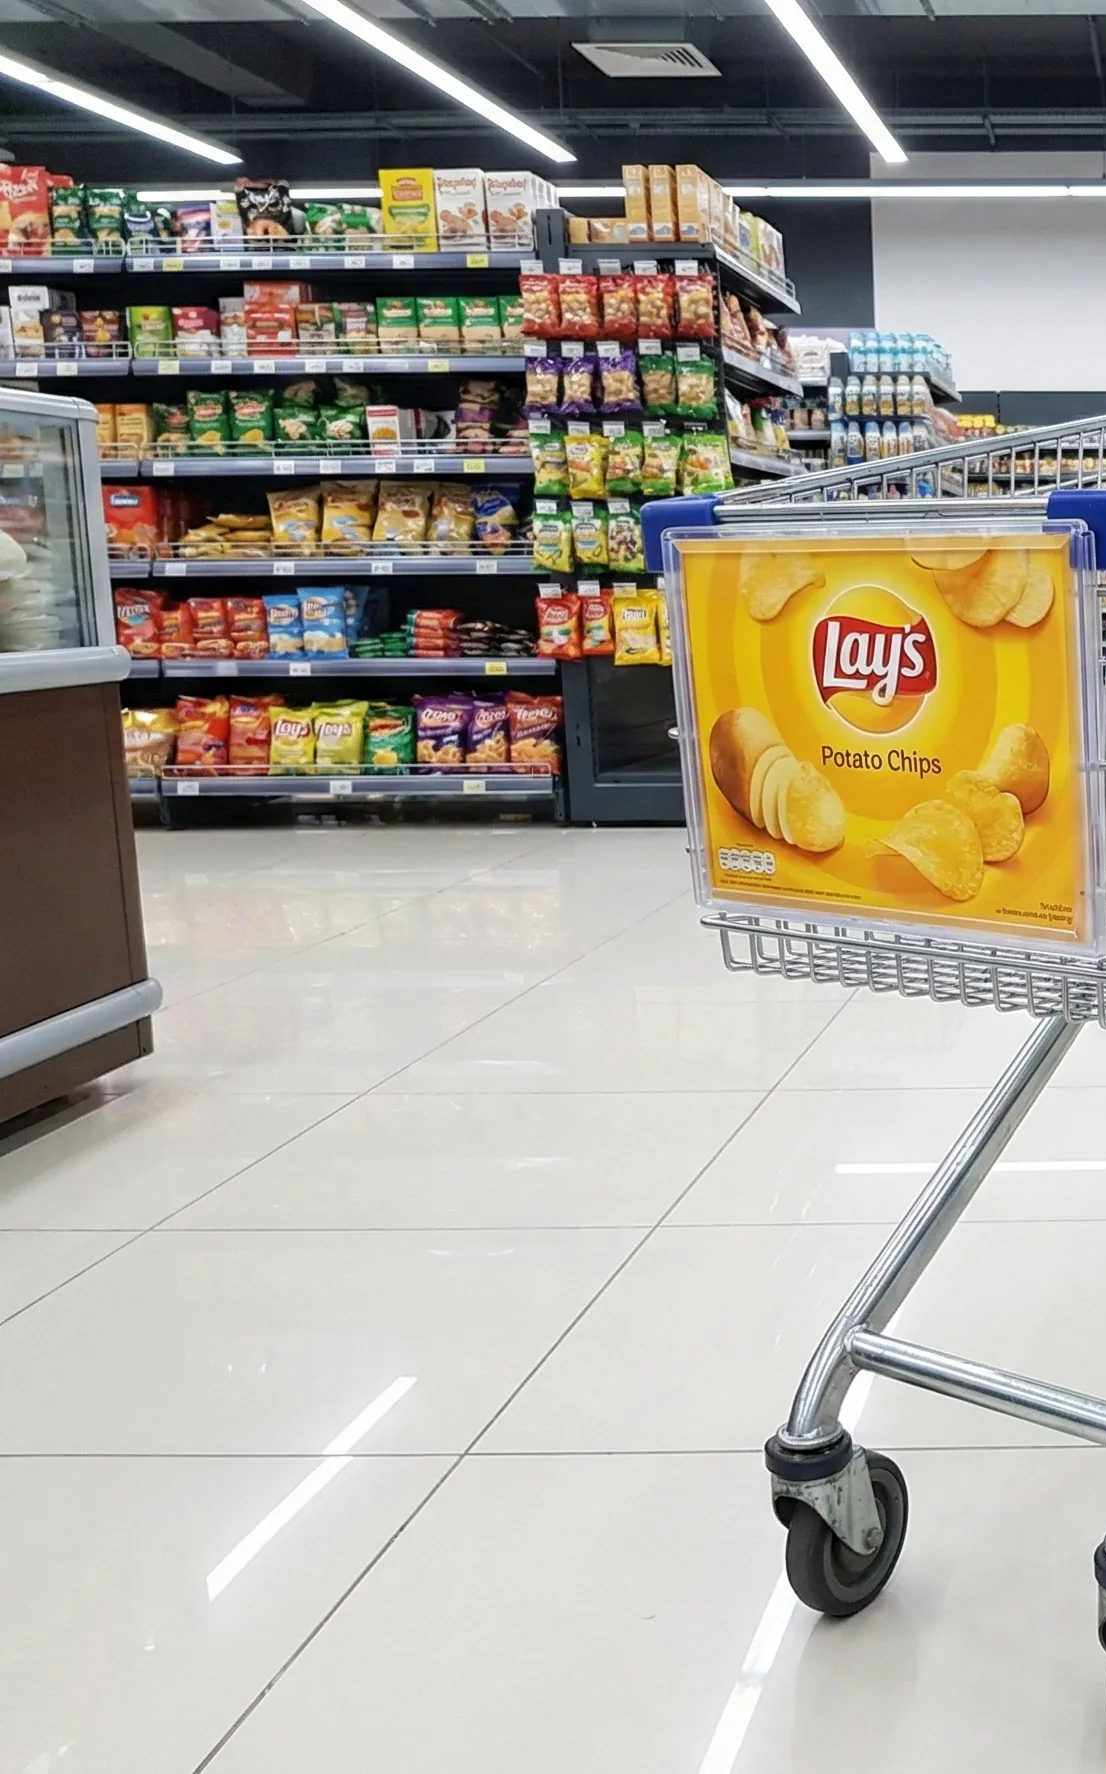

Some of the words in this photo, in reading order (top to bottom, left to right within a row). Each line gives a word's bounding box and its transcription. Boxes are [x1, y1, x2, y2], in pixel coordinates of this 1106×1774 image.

[822, 621, 927, 706] Lay's
[821, 745, 883, 771] Potato
[887, 749, 942, 780] Chips
